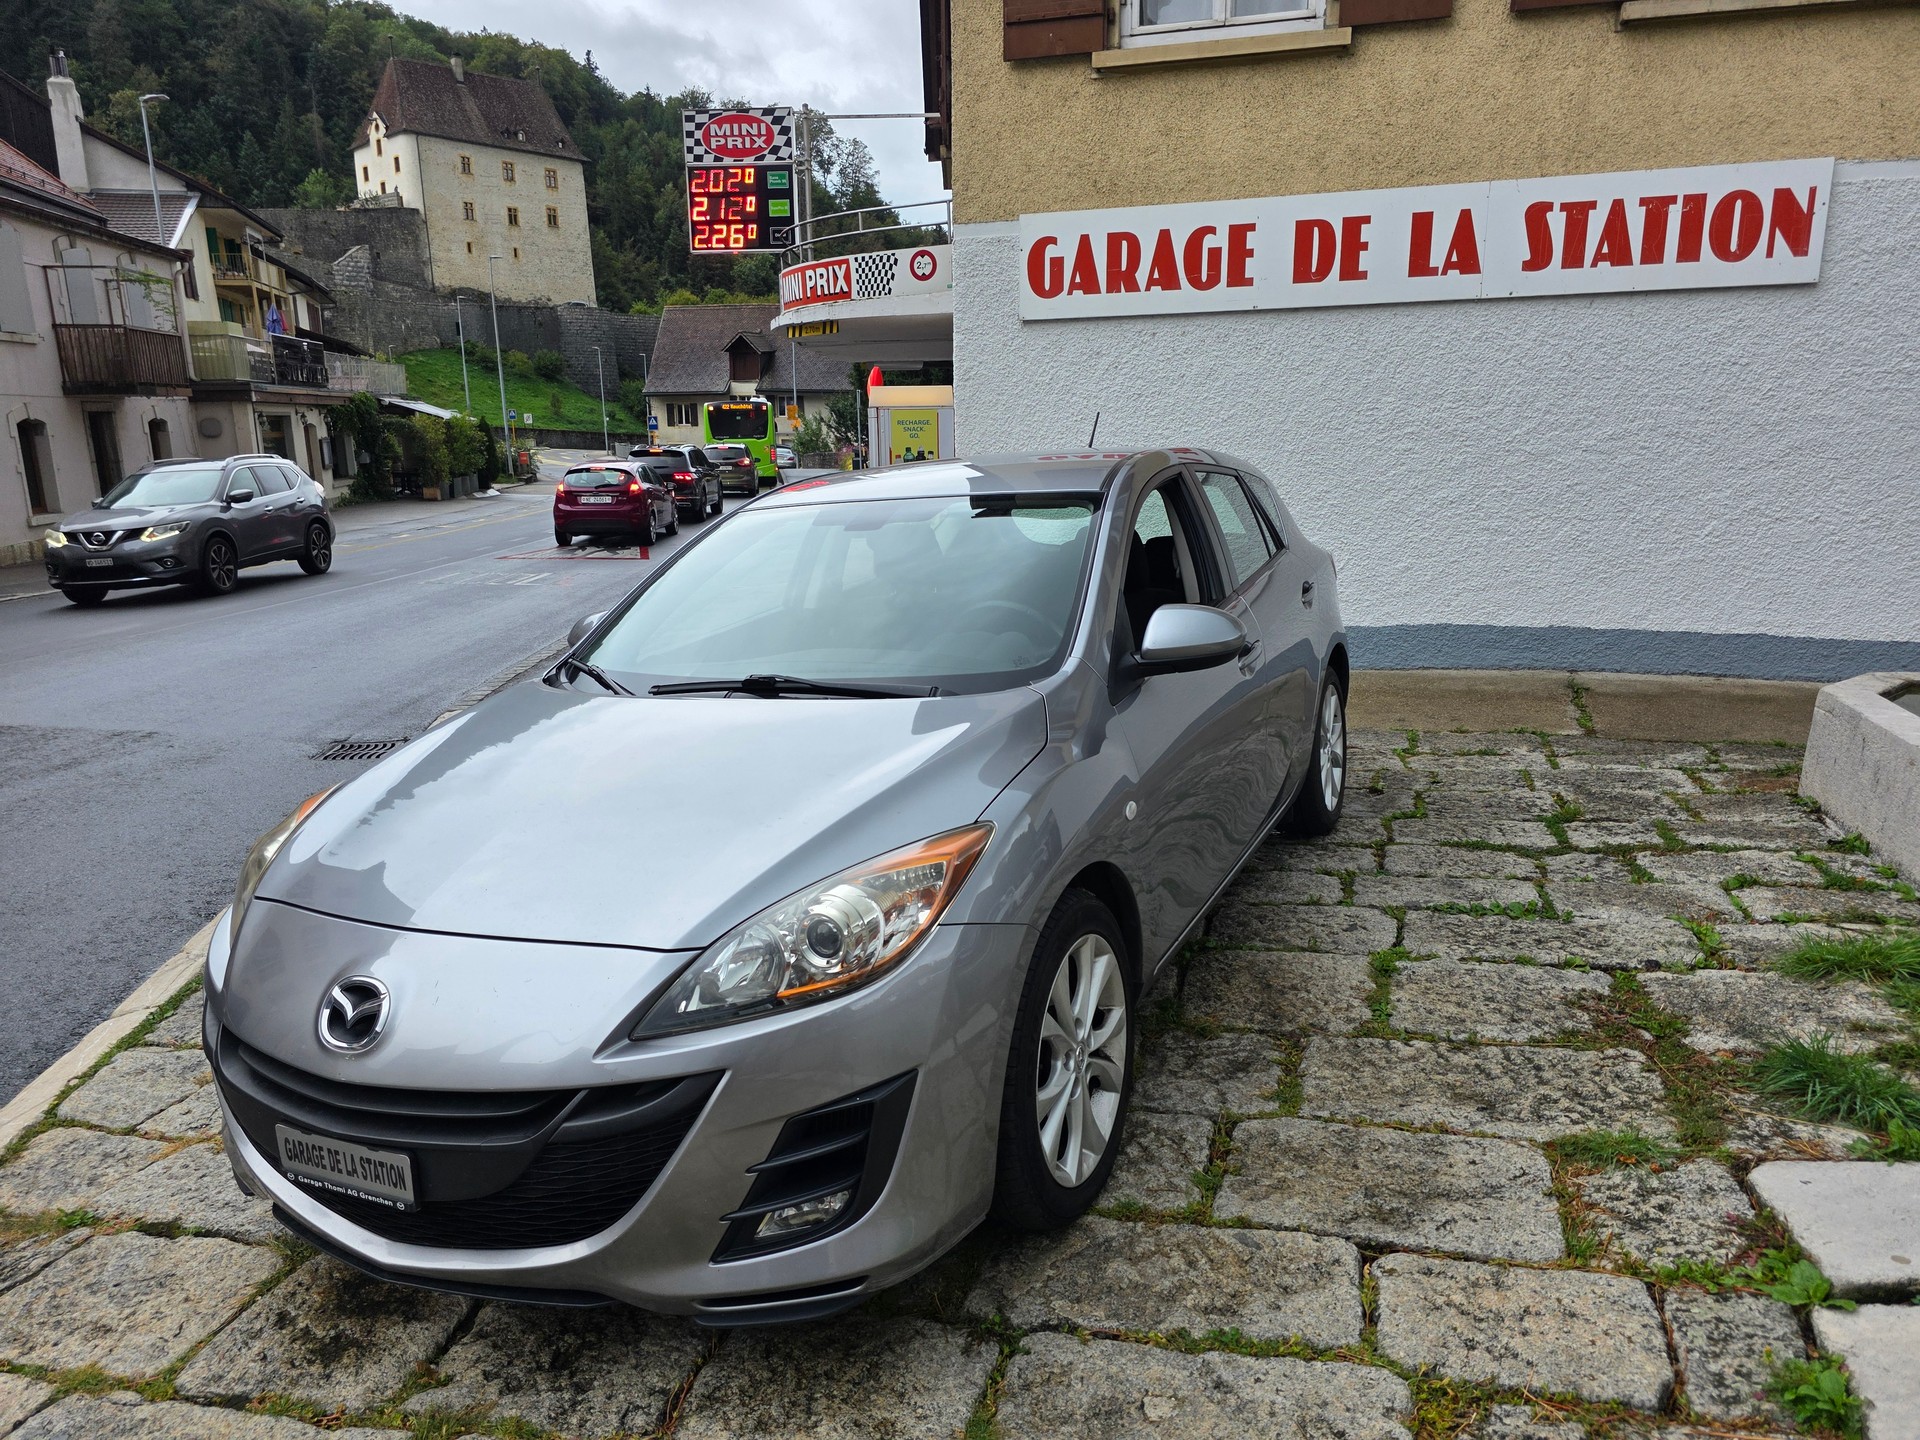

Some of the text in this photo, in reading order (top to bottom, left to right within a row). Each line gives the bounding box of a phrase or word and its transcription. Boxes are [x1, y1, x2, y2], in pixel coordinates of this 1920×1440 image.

[709, 123, 767, 136] MINI
[710, 136, 768, 149] PRIX
[1027, 186, 1818, 299] GARAGE DE LA STATION
[782, 263, 849, 304] MINI PRIX
[284, 1137, 407, 1191] GARAGE DE LA STATION
[298, 1175, 394, 1206] Garage Thomi AG Grenchen
